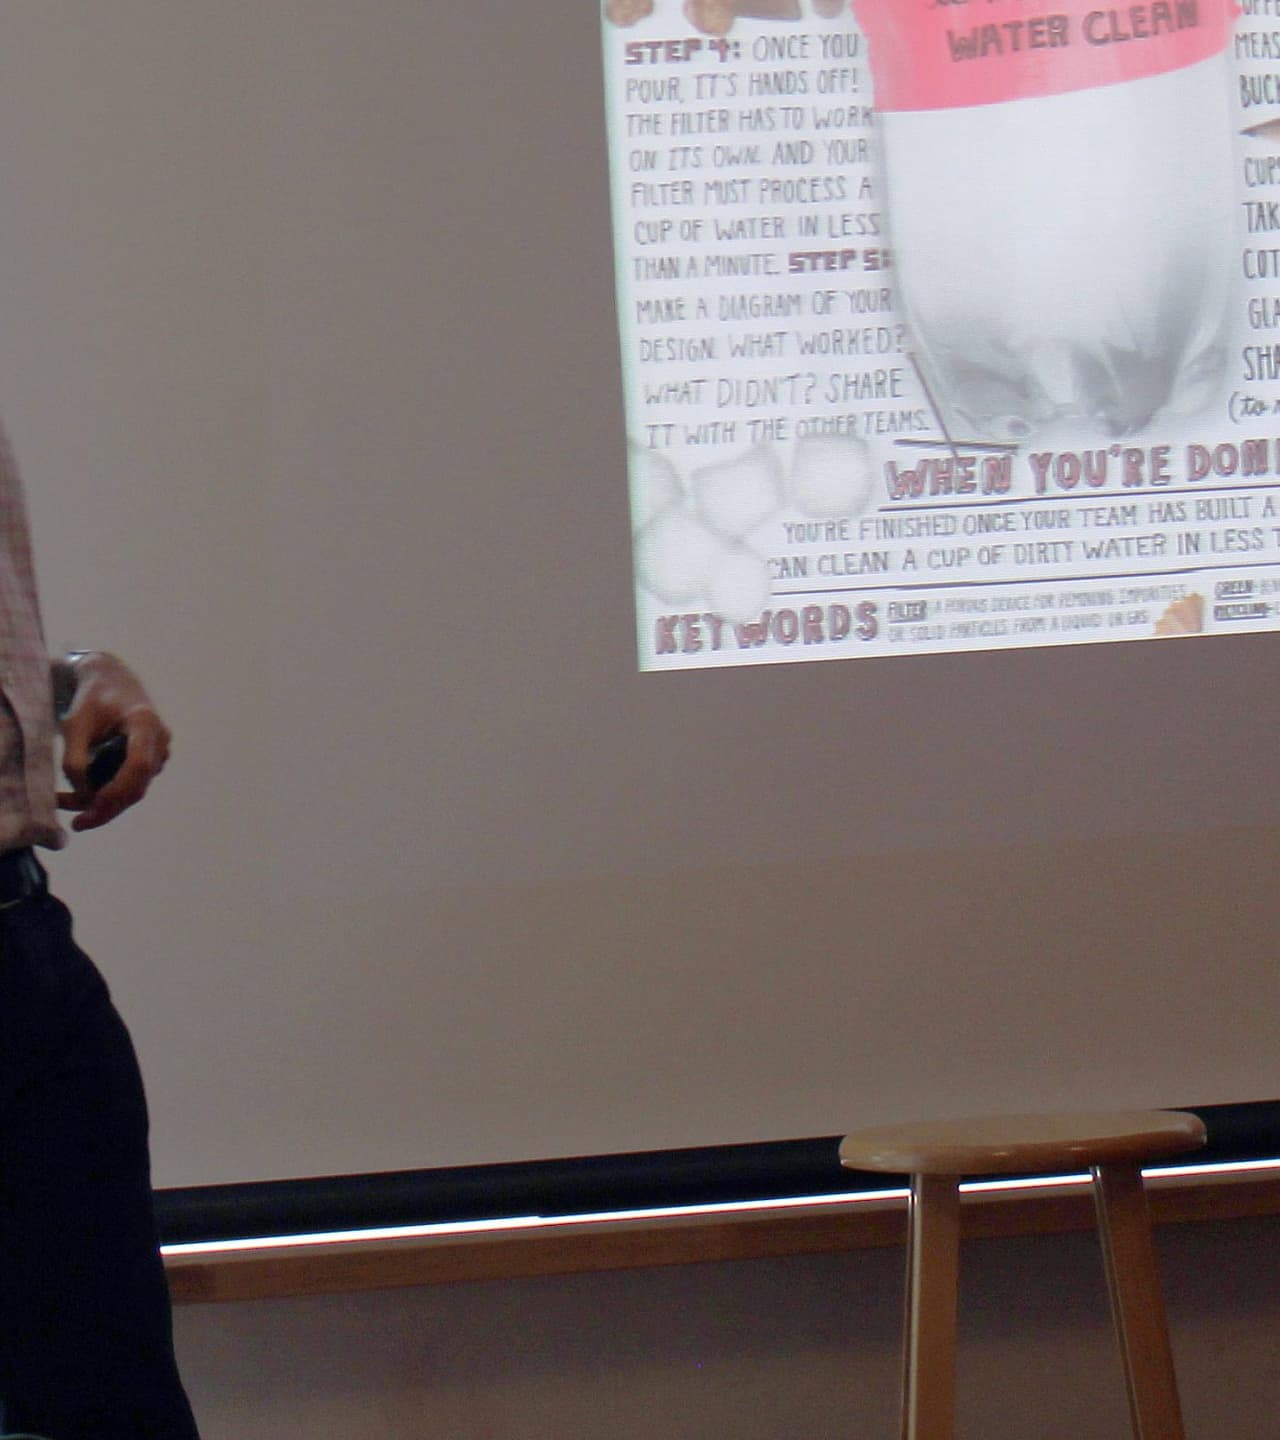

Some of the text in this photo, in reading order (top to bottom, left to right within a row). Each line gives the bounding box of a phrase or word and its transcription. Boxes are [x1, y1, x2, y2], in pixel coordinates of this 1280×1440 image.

[623, 34, 859, 65] STEP ONCE YOU
[946, 13, 1070, 62] WATER
[749, 70, 808, 97] HANDS
[670, 109, 729, 135] FILTER
[634, 213, 881, 245] CUP OF WATER LESS
[788, 248, 856, 274] STEP
[635, 287, 892, 324] MAKE DIAGRAM YOUR
[728, 331, 788, 358] WHAT
[644, 368, 904, 405] WHAT SHARE
[645, 417, 786, 449] IT WITH THE
[883, 453, 1012, 500] WHEN
[1029, 443, 1171, 495] YOU'RE
[858, 513, 957, 540] FINISHED
[962, 510, 1016, 534] ONCE
[1020, 509, 1070, 531] YOUR
[1082, 504, 1137, 529] TEAM
[1148, 500, 1186, 524] HAS
[817, 549, 889, 576] CLEAN
[927, 546, 971, 571] CUP
[975, 544, 1003, 566] OF
[1083, 534, 1168, 560] WATER
[1177, 532, 1200, 555] IN
[1209, 528, 1265, 554] LESS
[654, 601, 879, 655] KEYWORDS
